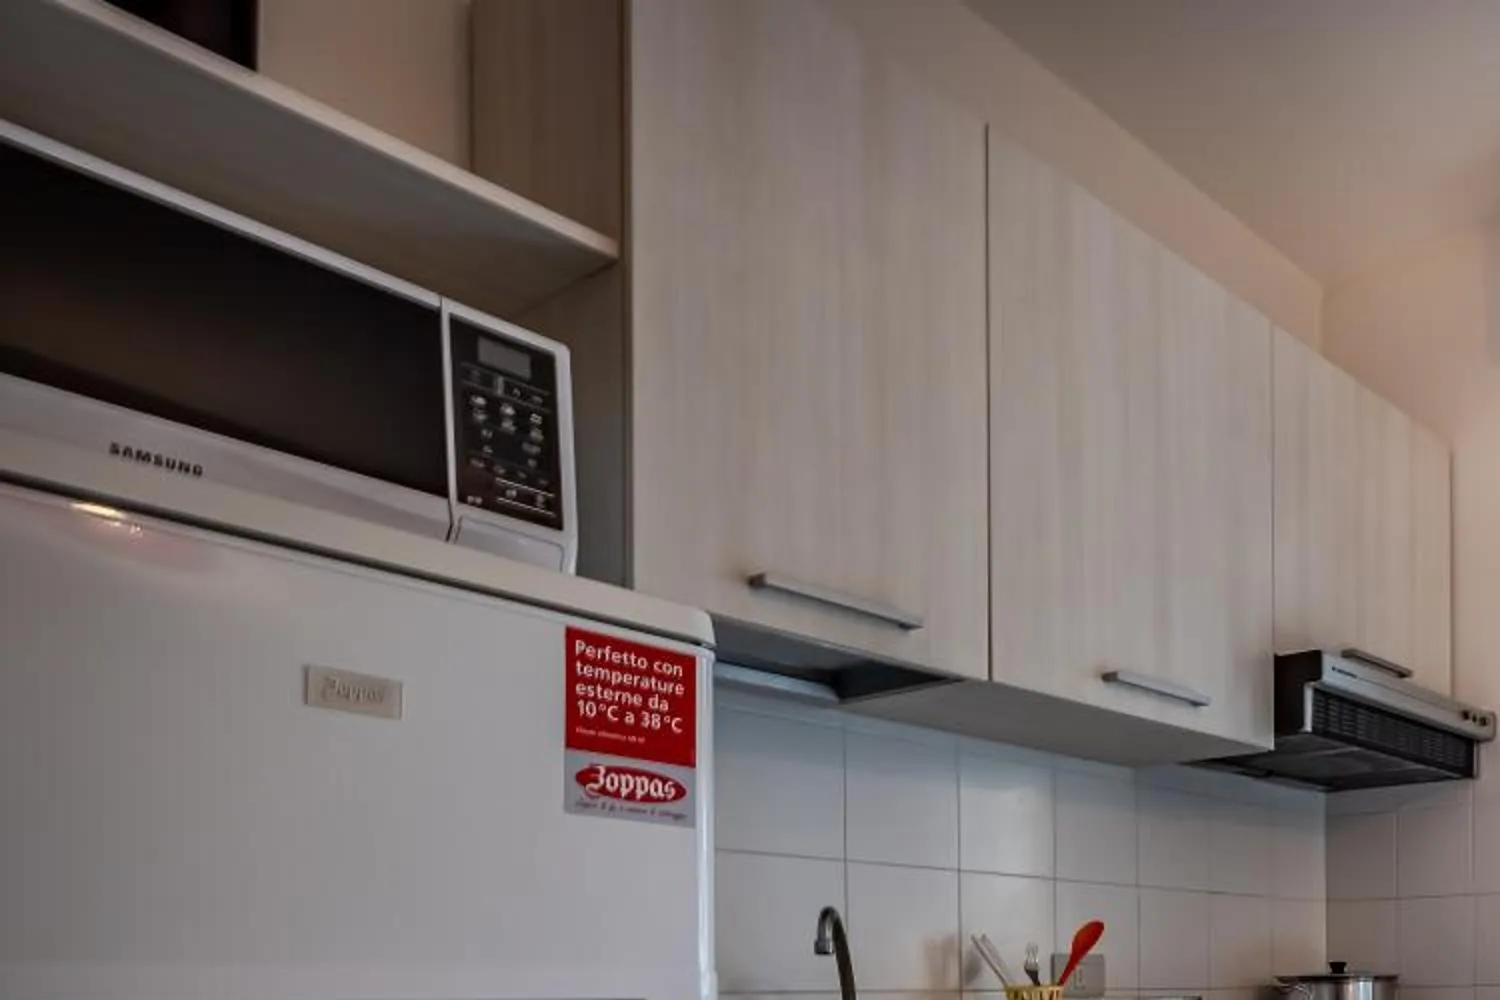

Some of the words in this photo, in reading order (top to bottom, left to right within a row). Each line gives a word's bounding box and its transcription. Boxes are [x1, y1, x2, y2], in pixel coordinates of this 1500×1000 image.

[109, 442, 203, 476] SAMSUNG
[575, 639, 648, 669] Perfetto
[653, 661, 683, 677] con
[576, 661, 685, 695] temperature
[575, 683, 642, 707] esterne
[648, 694, 669, 712] da
[578, 699, 619, 721] 10°C
[624, 711, 635, 725] a
[641, 711, 682, 734] 38°C
